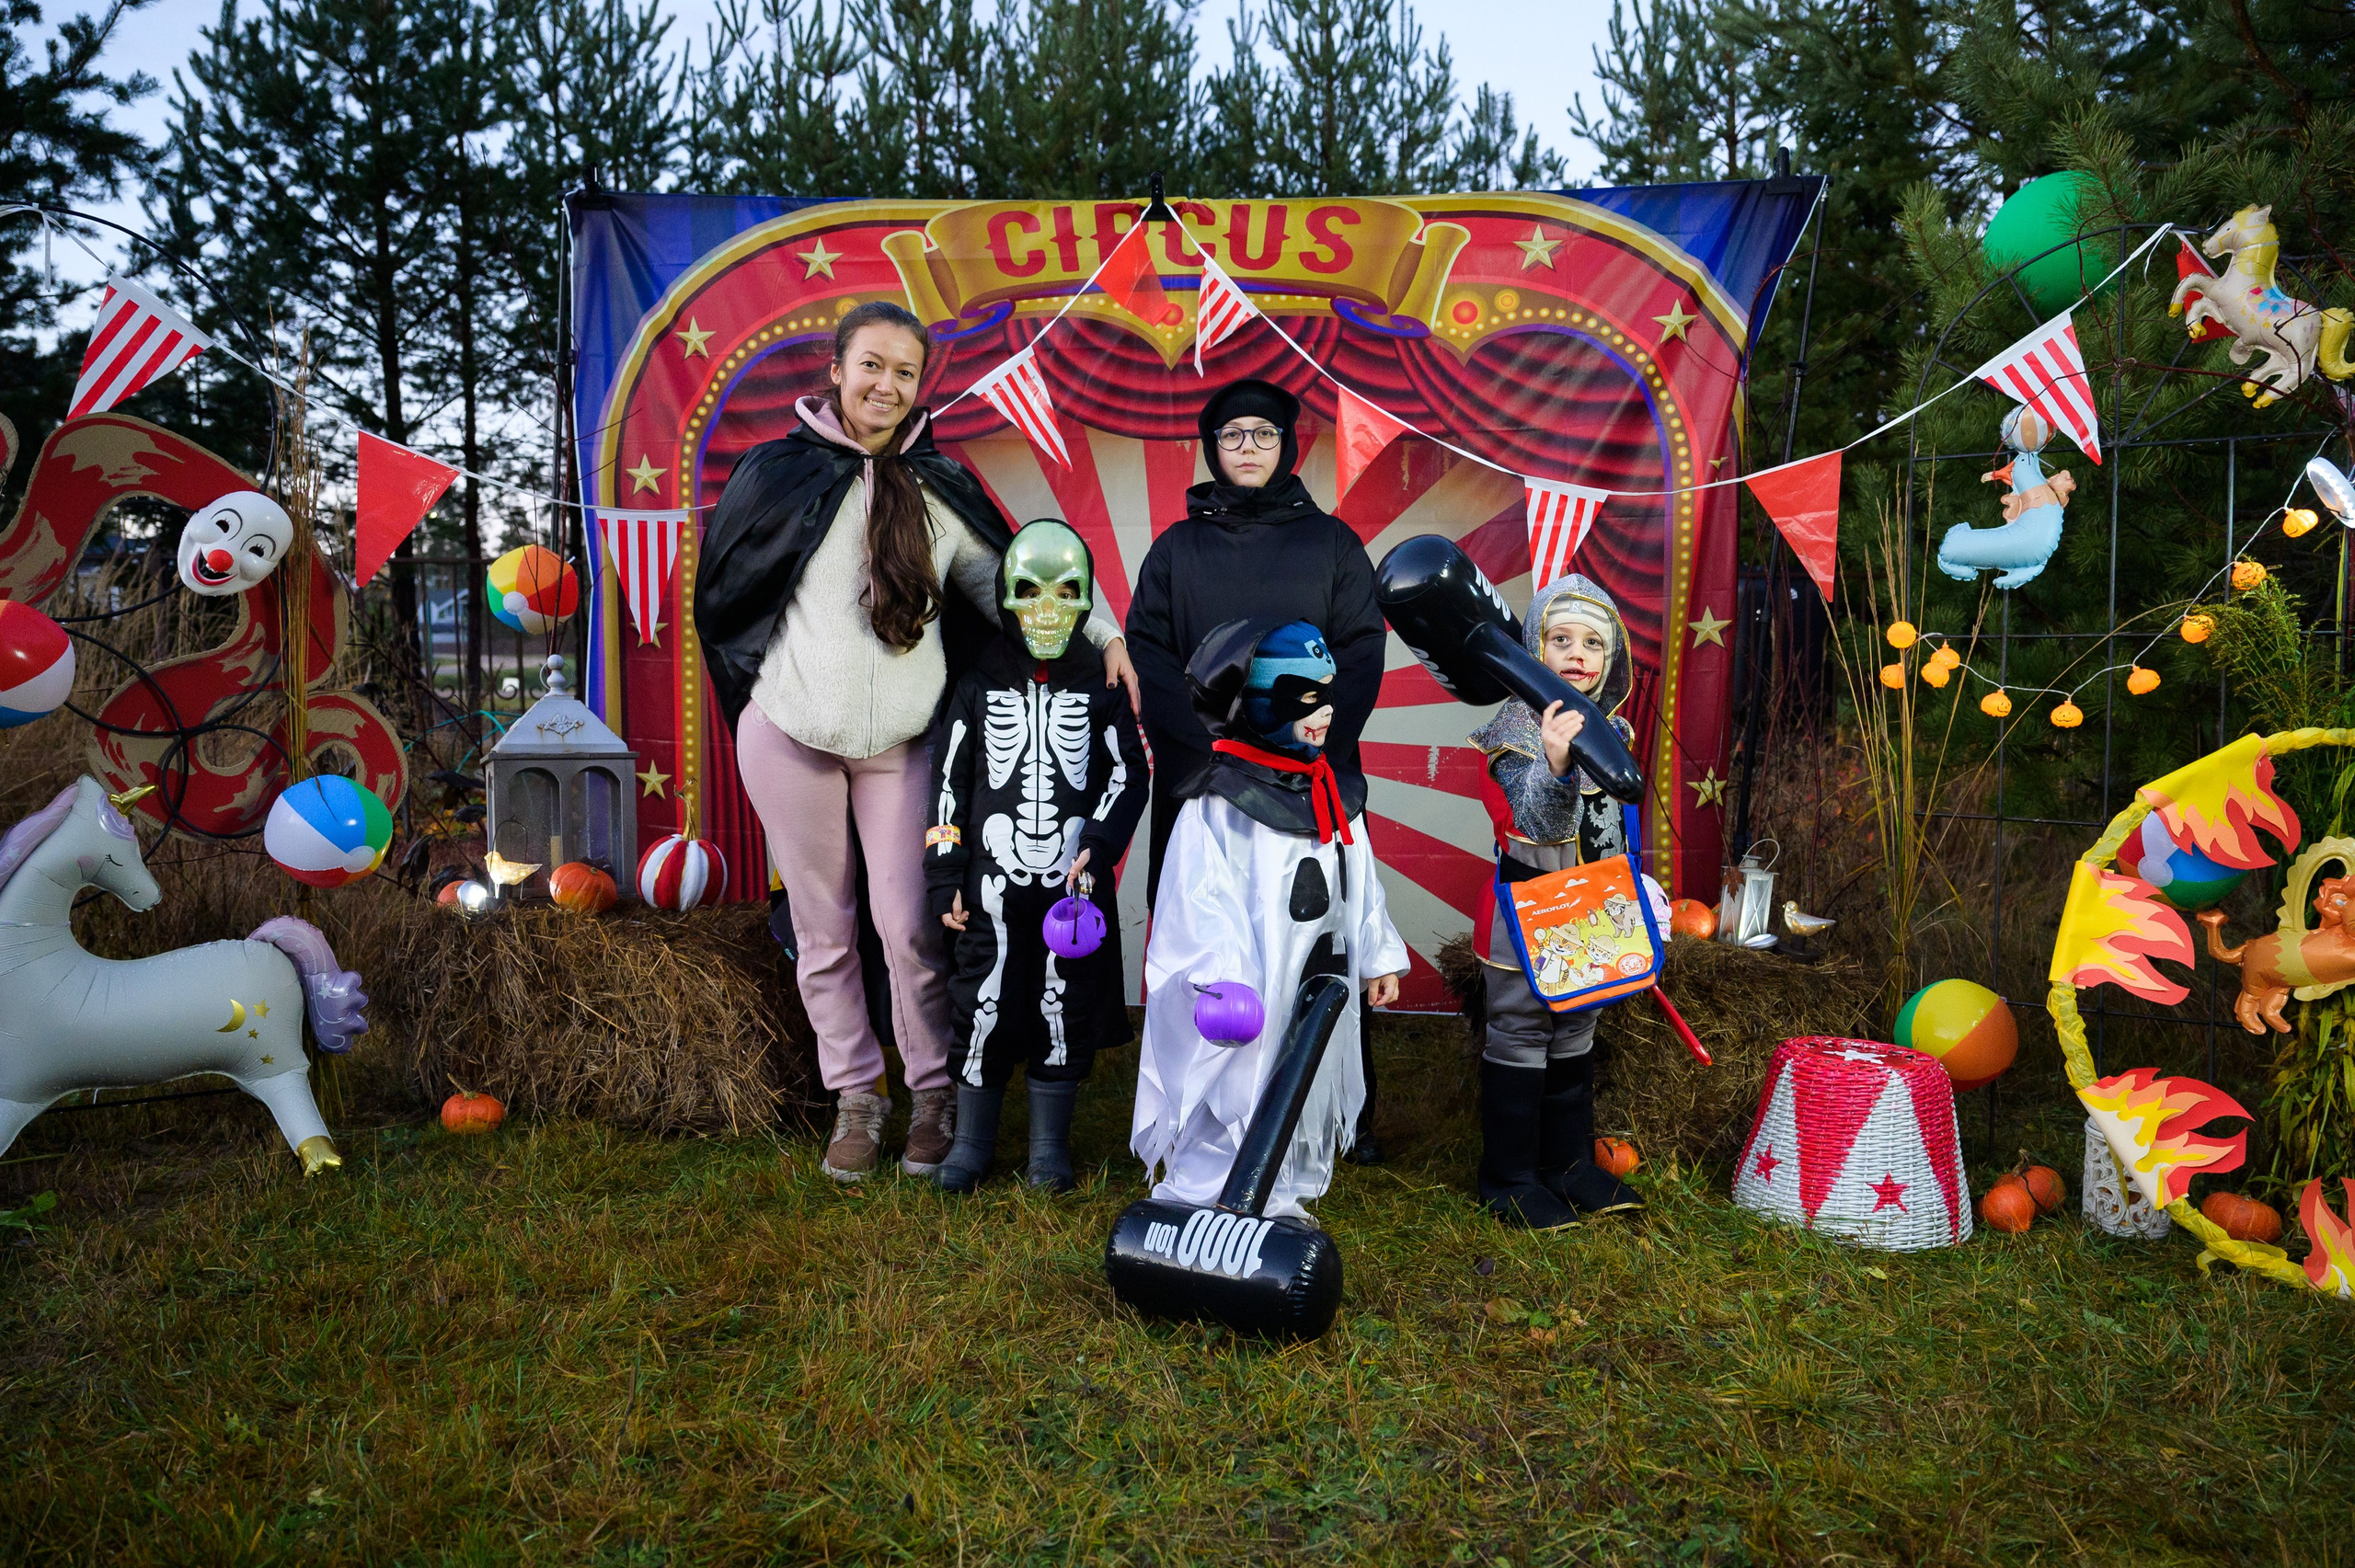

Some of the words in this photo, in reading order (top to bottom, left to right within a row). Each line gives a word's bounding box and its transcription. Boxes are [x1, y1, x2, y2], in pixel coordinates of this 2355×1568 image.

[1532, 902, 1570, 916] AEROFLOT
[1143, 1221, 1178, 1259] ton
[1177, 1209, 1275, 1279] 1000
